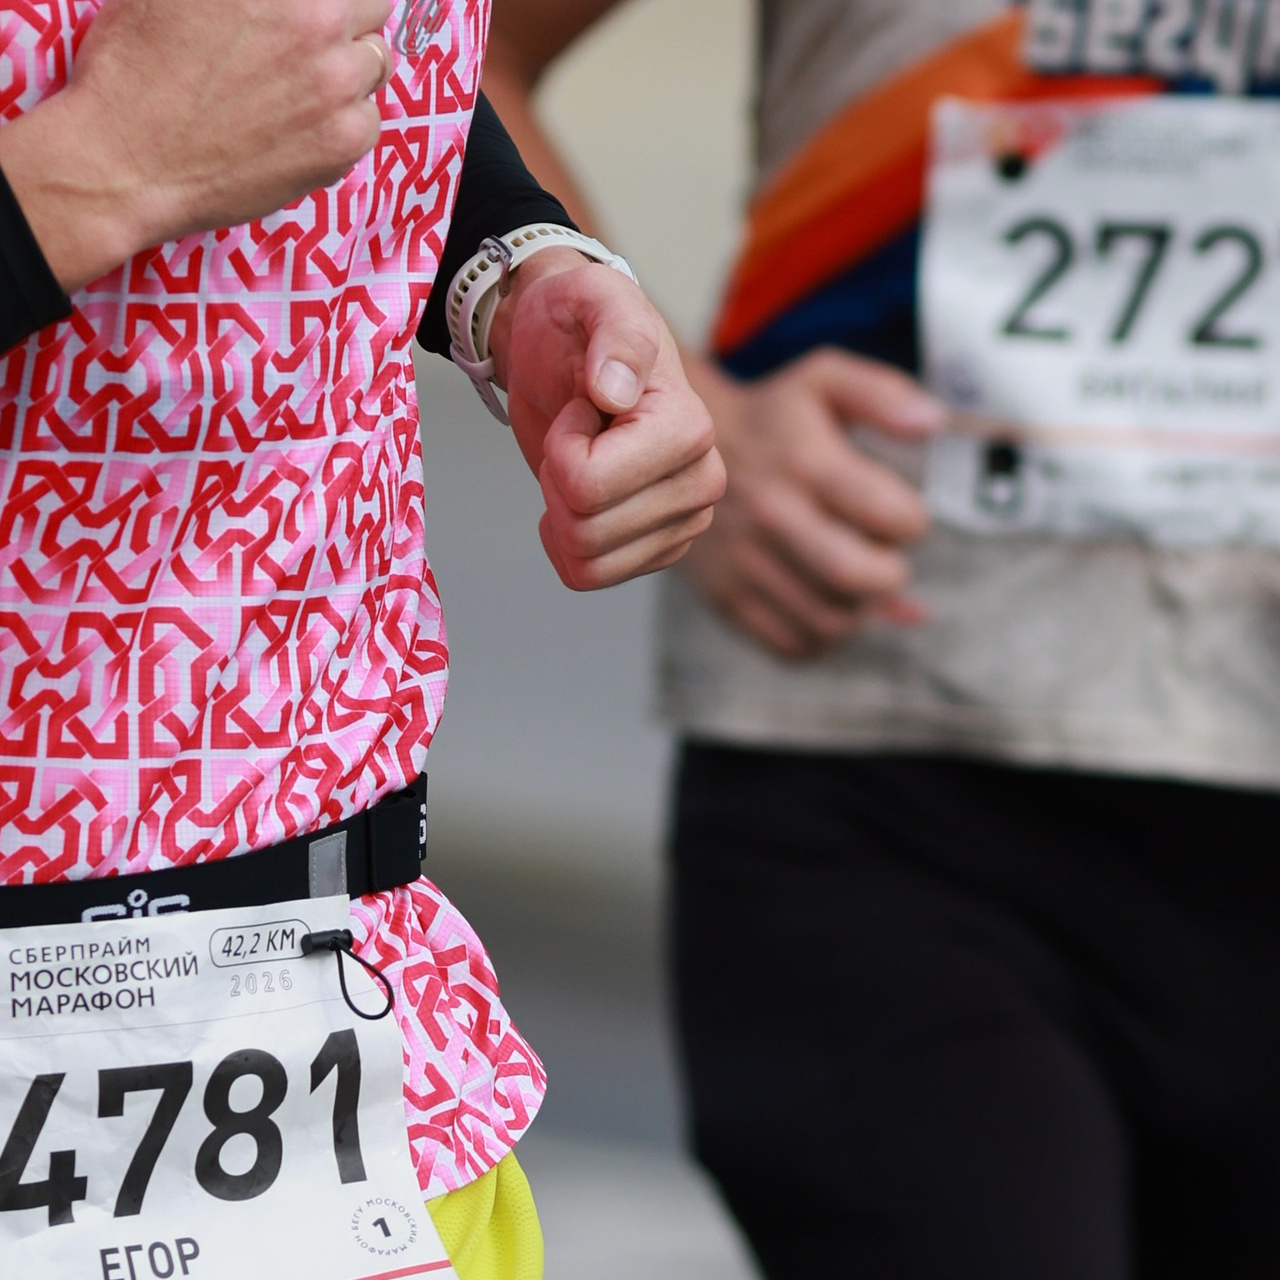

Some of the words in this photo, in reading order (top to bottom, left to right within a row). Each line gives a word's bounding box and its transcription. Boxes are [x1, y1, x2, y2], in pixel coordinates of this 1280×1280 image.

[1000, 217, 1280, 350] 272
[9, 937, 151, 966] СБЕРПРАЙМ
[221, 933, 261, 960] 42,2
[10, 951, 199, 993] МОСКОВСКИЙ
[230, 970, 293, 997] 2026
[11, 987, 156, 1018] МАРАФОН
[372, 1217, 392, 1238] 1
